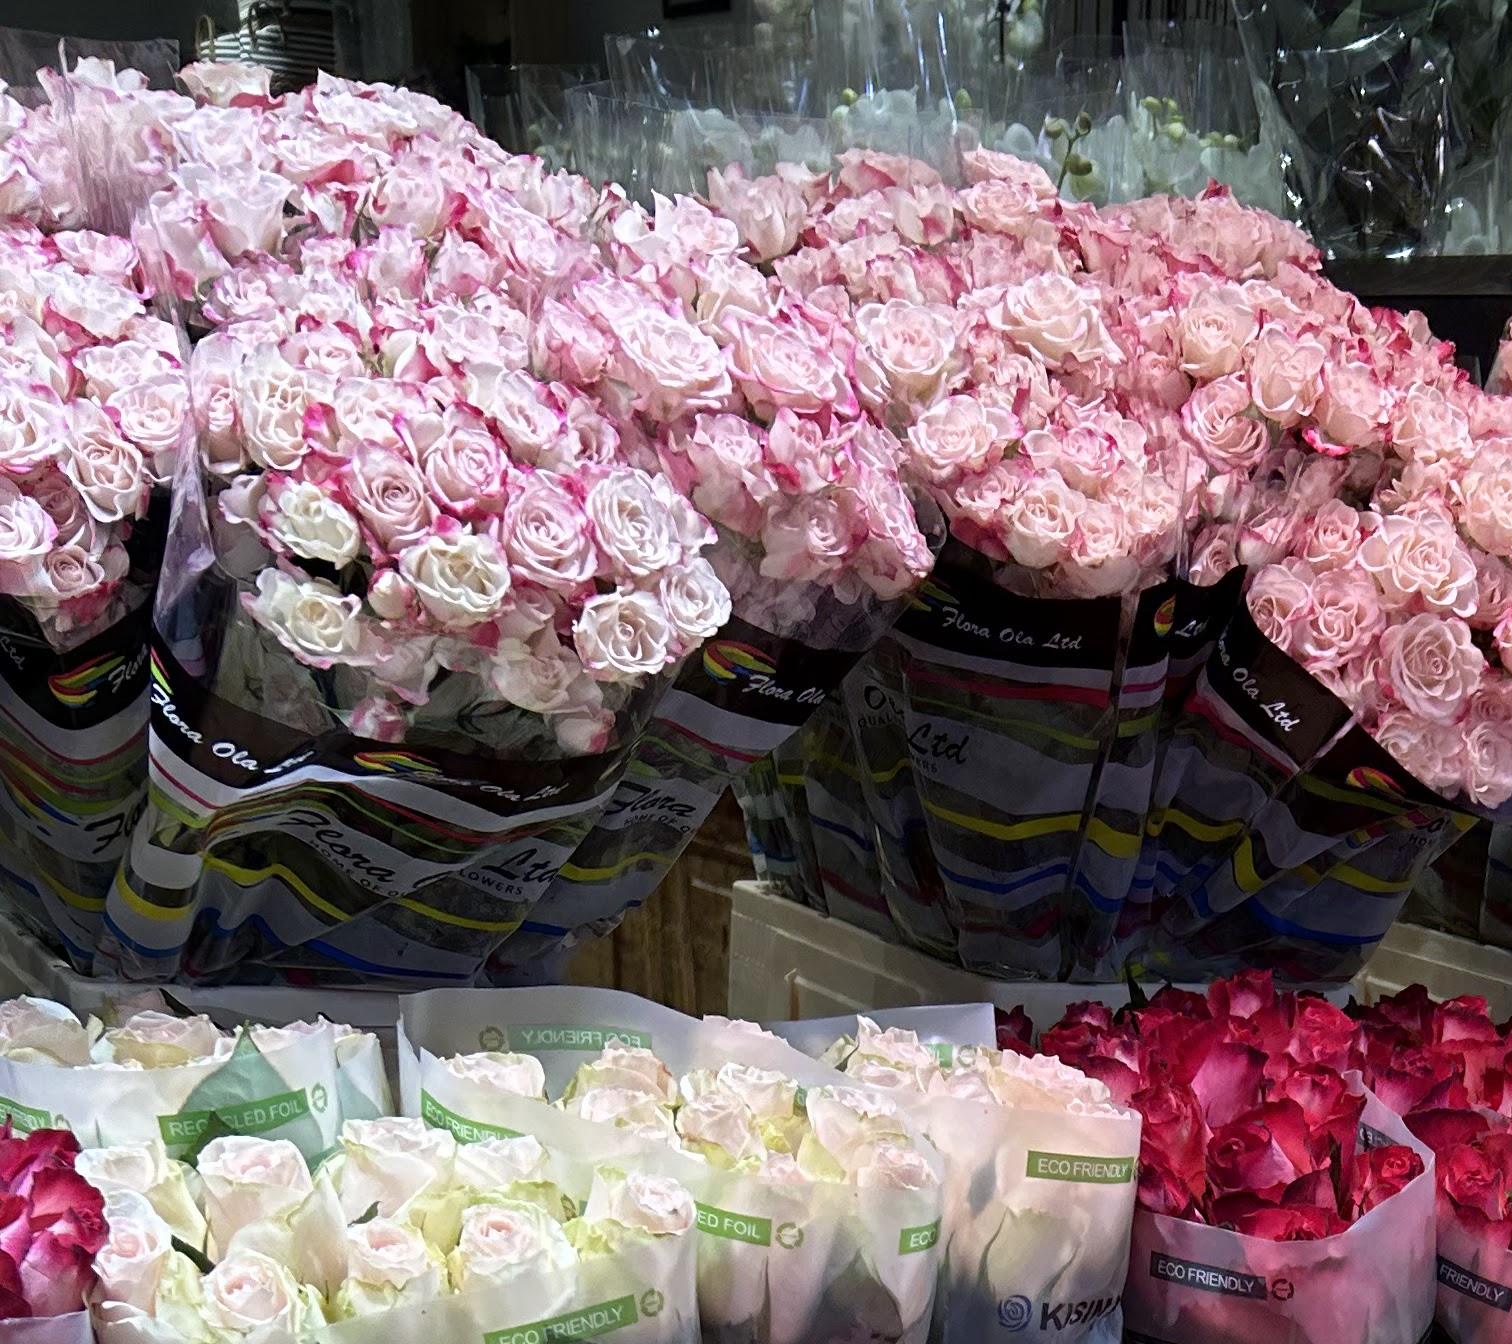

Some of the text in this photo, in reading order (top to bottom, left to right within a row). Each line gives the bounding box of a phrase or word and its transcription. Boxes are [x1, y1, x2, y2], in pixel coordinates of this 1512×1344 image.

[942, 605, 1083, 651] Flora Ola Ltd
[741, 674, 795, 702] Flora
[1232, 667, 1300, 733] Ola Ltd
[151, 682, 204, 744] Flora
[211, 741, 259, 772] Ola
[906, 723, 970, 765] Ltd
[603, 780, 697, 818] Flora
[459, 868, 524, 896] LOWERS
[268, 1100, 303, 1121] FOIL
[425, 1102, 445, 1126] ECO
[1038, 1158, 1130, 1180] ECO FRIENDLY
[722, 1217, 762, 1240] FOIL
[1157, 1259, 1255, 1294] ECO FRIENDLY
[1439, 1263, 1505, 1302] FRIENDLY
[542, 1305, 625, 1344] FRIENDLY
